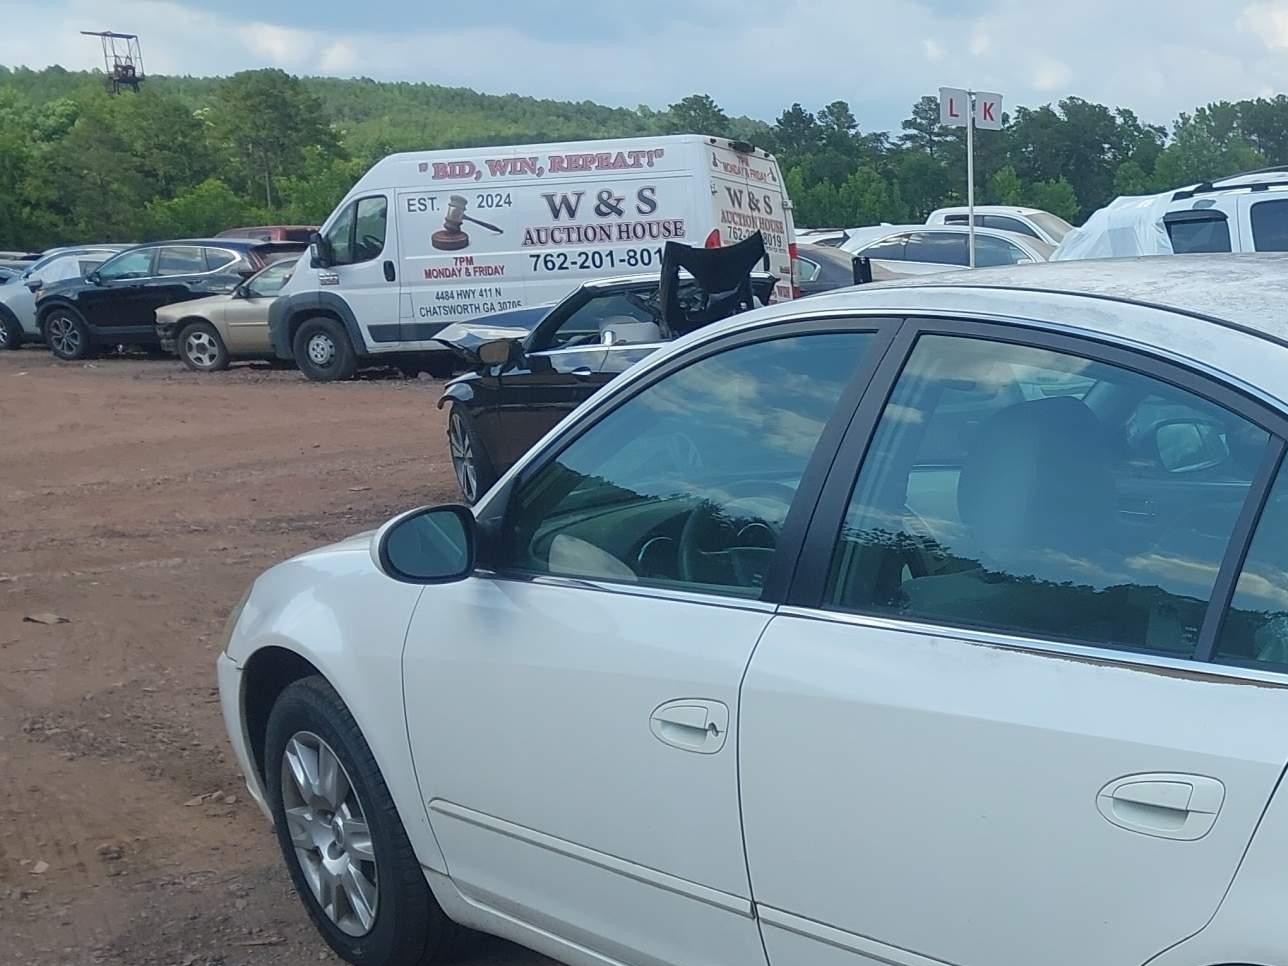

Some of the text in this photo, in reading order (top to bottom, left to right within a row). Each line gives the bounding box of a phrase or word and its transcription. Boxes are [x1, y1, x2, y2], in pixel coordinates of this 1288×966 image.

[950, 98, 959, 117] L
[983, 101, 995, 121] K
[485, 157, 545, 178] WIN,
[548, 149, 664, 173] REPEAT!"
[407, 193, 512, 212] EST. 2024
[541, 186, 657, 220] W & S
[725, 186, 773, 215] W & S
[721, 208, 784, 234] AUCTION HOUSE
[522, 219, 685, 247] AUCTION HOUSE
[453, 256, 474, 266] 7PM
[529, 247, 662, 272] 762-201-801
[424, 265, 505, 279] MONDAY & FRIDAY
[435, 287, 502, 301] 4484 HWY 411 N
[420, 303, 480, 318] CHATSWORTH
[483, 302, 496, 313] GA
